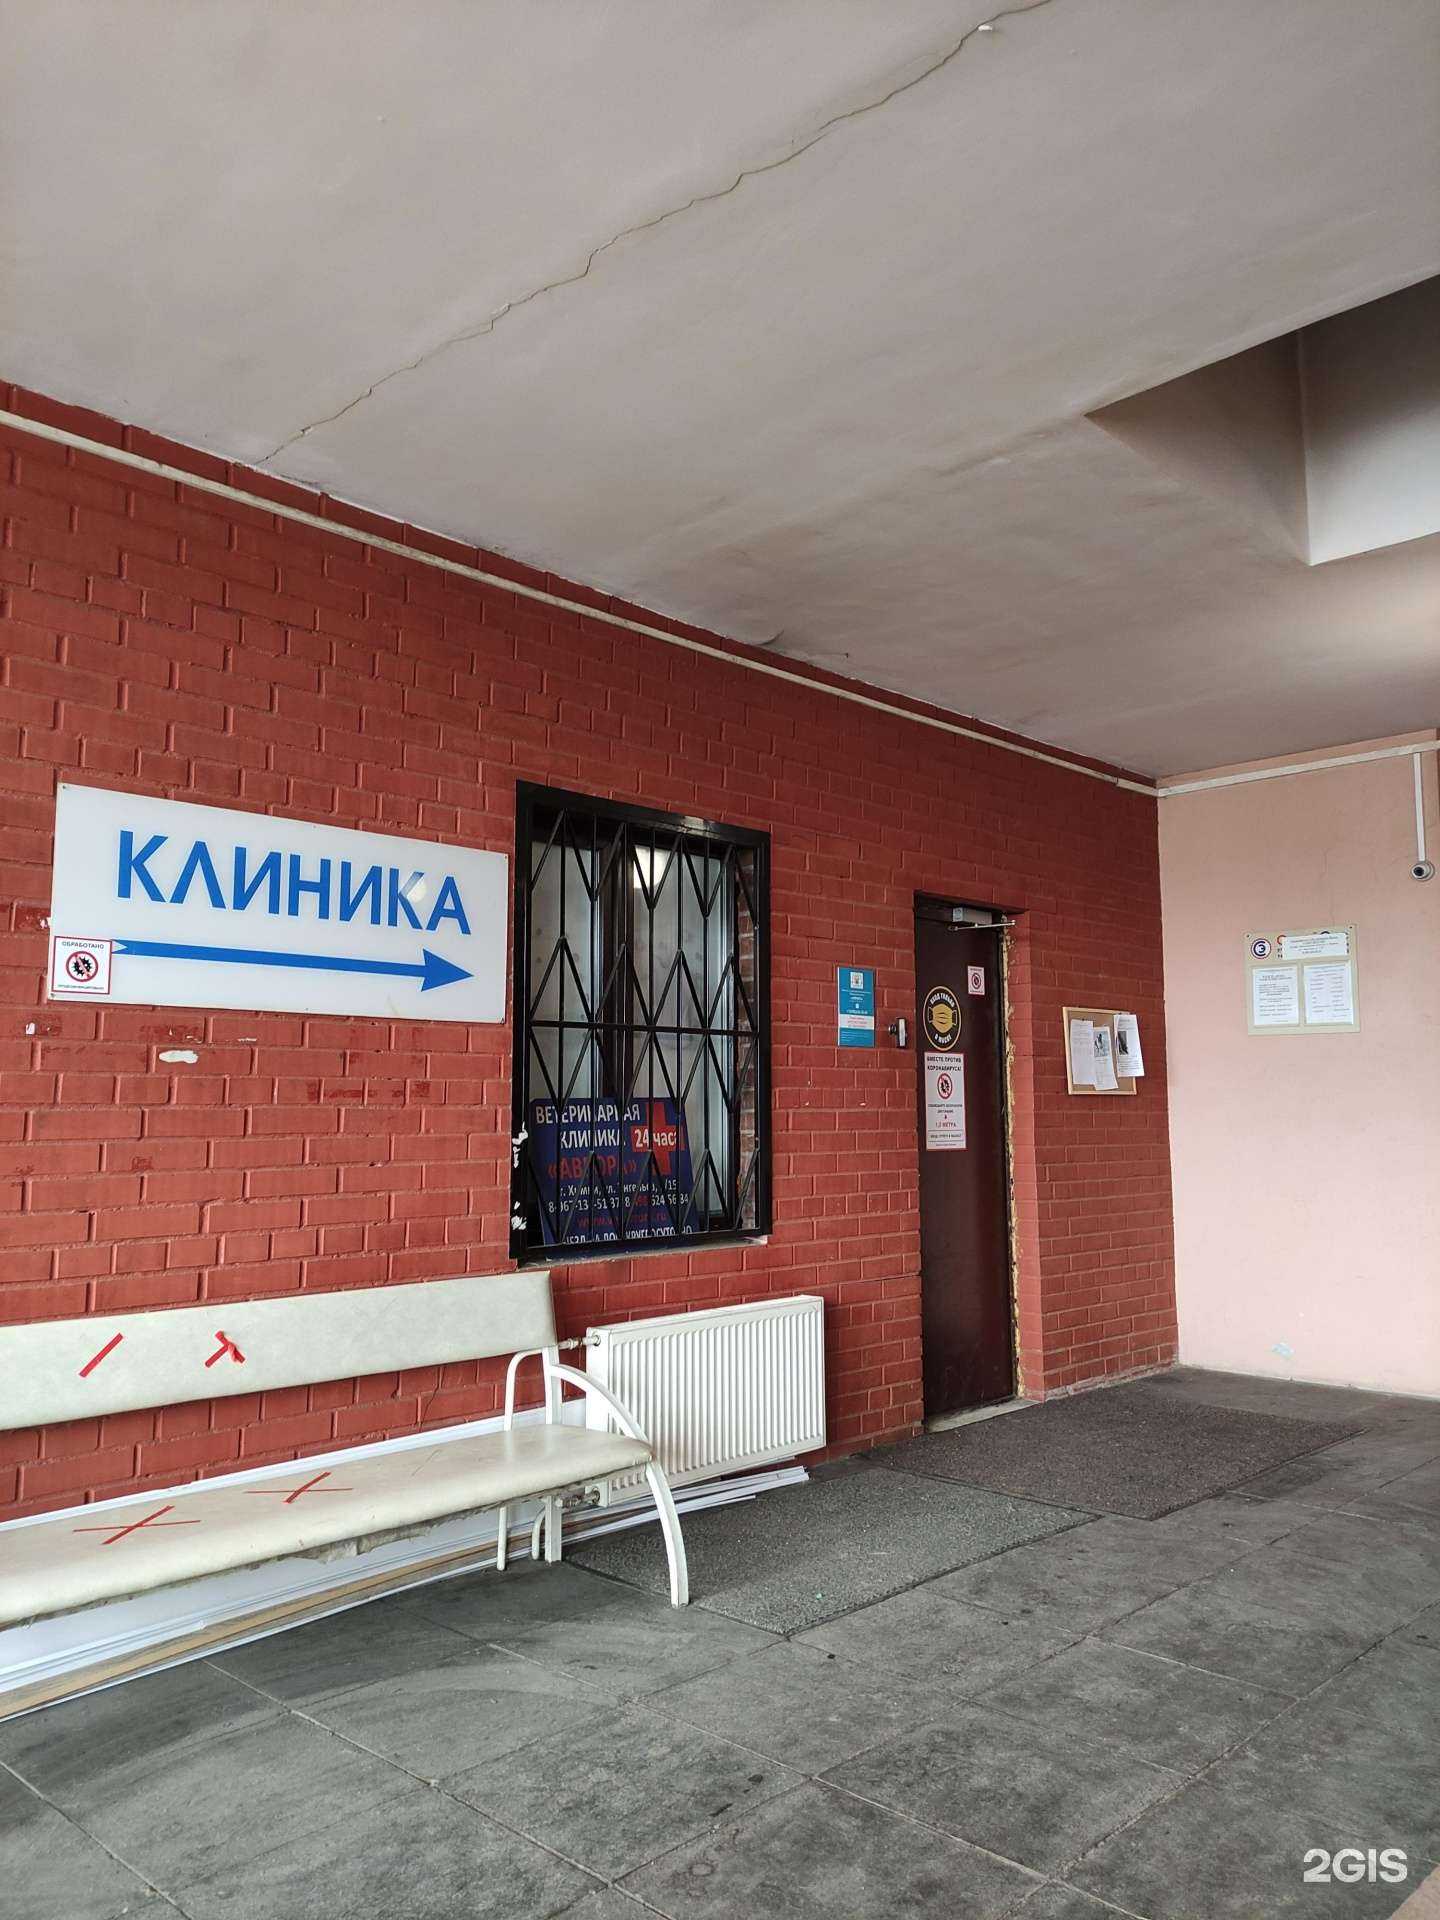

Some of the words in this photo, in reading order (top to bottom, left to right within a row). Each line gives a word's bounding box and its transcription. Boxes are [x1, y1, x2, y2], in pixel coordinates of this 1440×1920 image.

[117, 829, 472, 936] КЛИНИКА
[61, 941, 104, 949] ОБРАБОТАНО
[634, 1127, 649, 1149] 24
